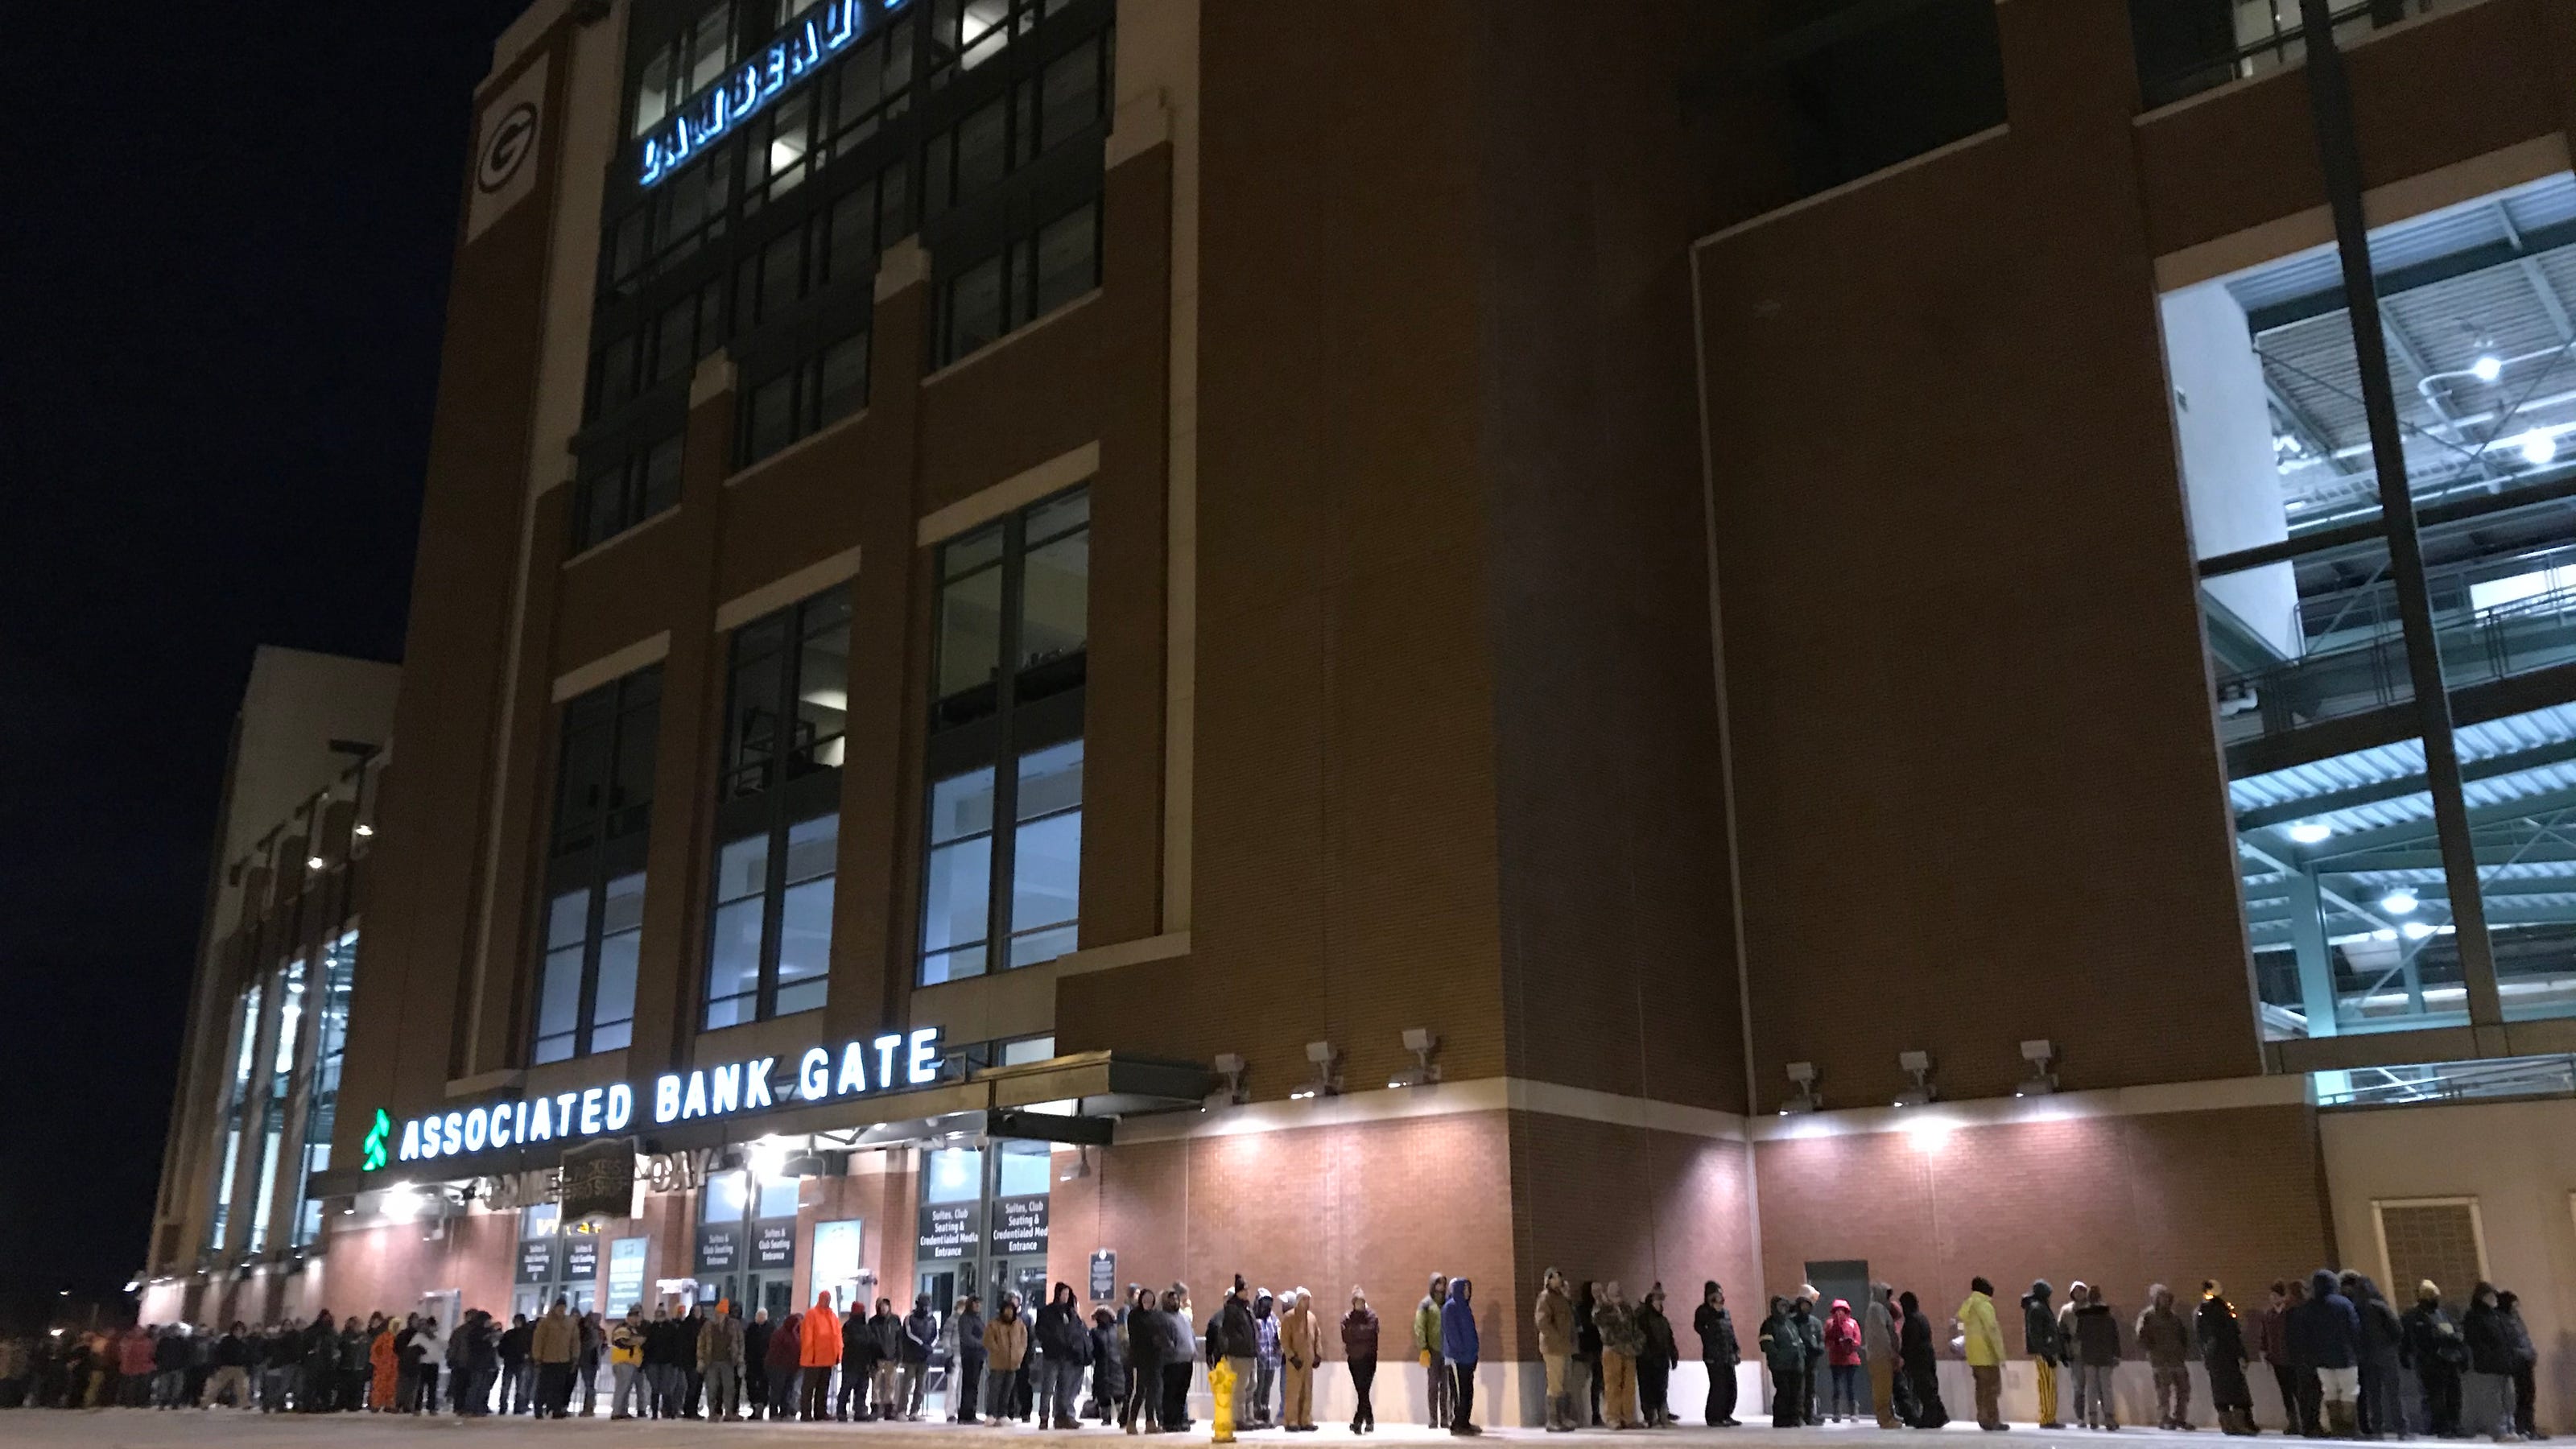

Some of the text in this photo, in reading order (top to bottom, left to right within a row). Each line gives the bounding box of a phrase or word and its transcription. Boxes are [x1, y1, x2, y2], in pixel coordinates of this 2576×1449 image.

[398, 1028, 938, 1161] ASSOCIATED BANK GATE
[1029, 1200, 1043, 1212] Club
[955, 1208, 968, 1219] Club
[935, 1221, 959, 1233] Seating
[1008, 1215, 1033, 1227] Seating
[920, 1232, 979, 1246] Credentialed Media
[993, 1225, 1048, 1241] Credentialed Med
[935, 1246, 962, 1257] Entrance
[1009, 1241, 1038, 1252] Entrance
